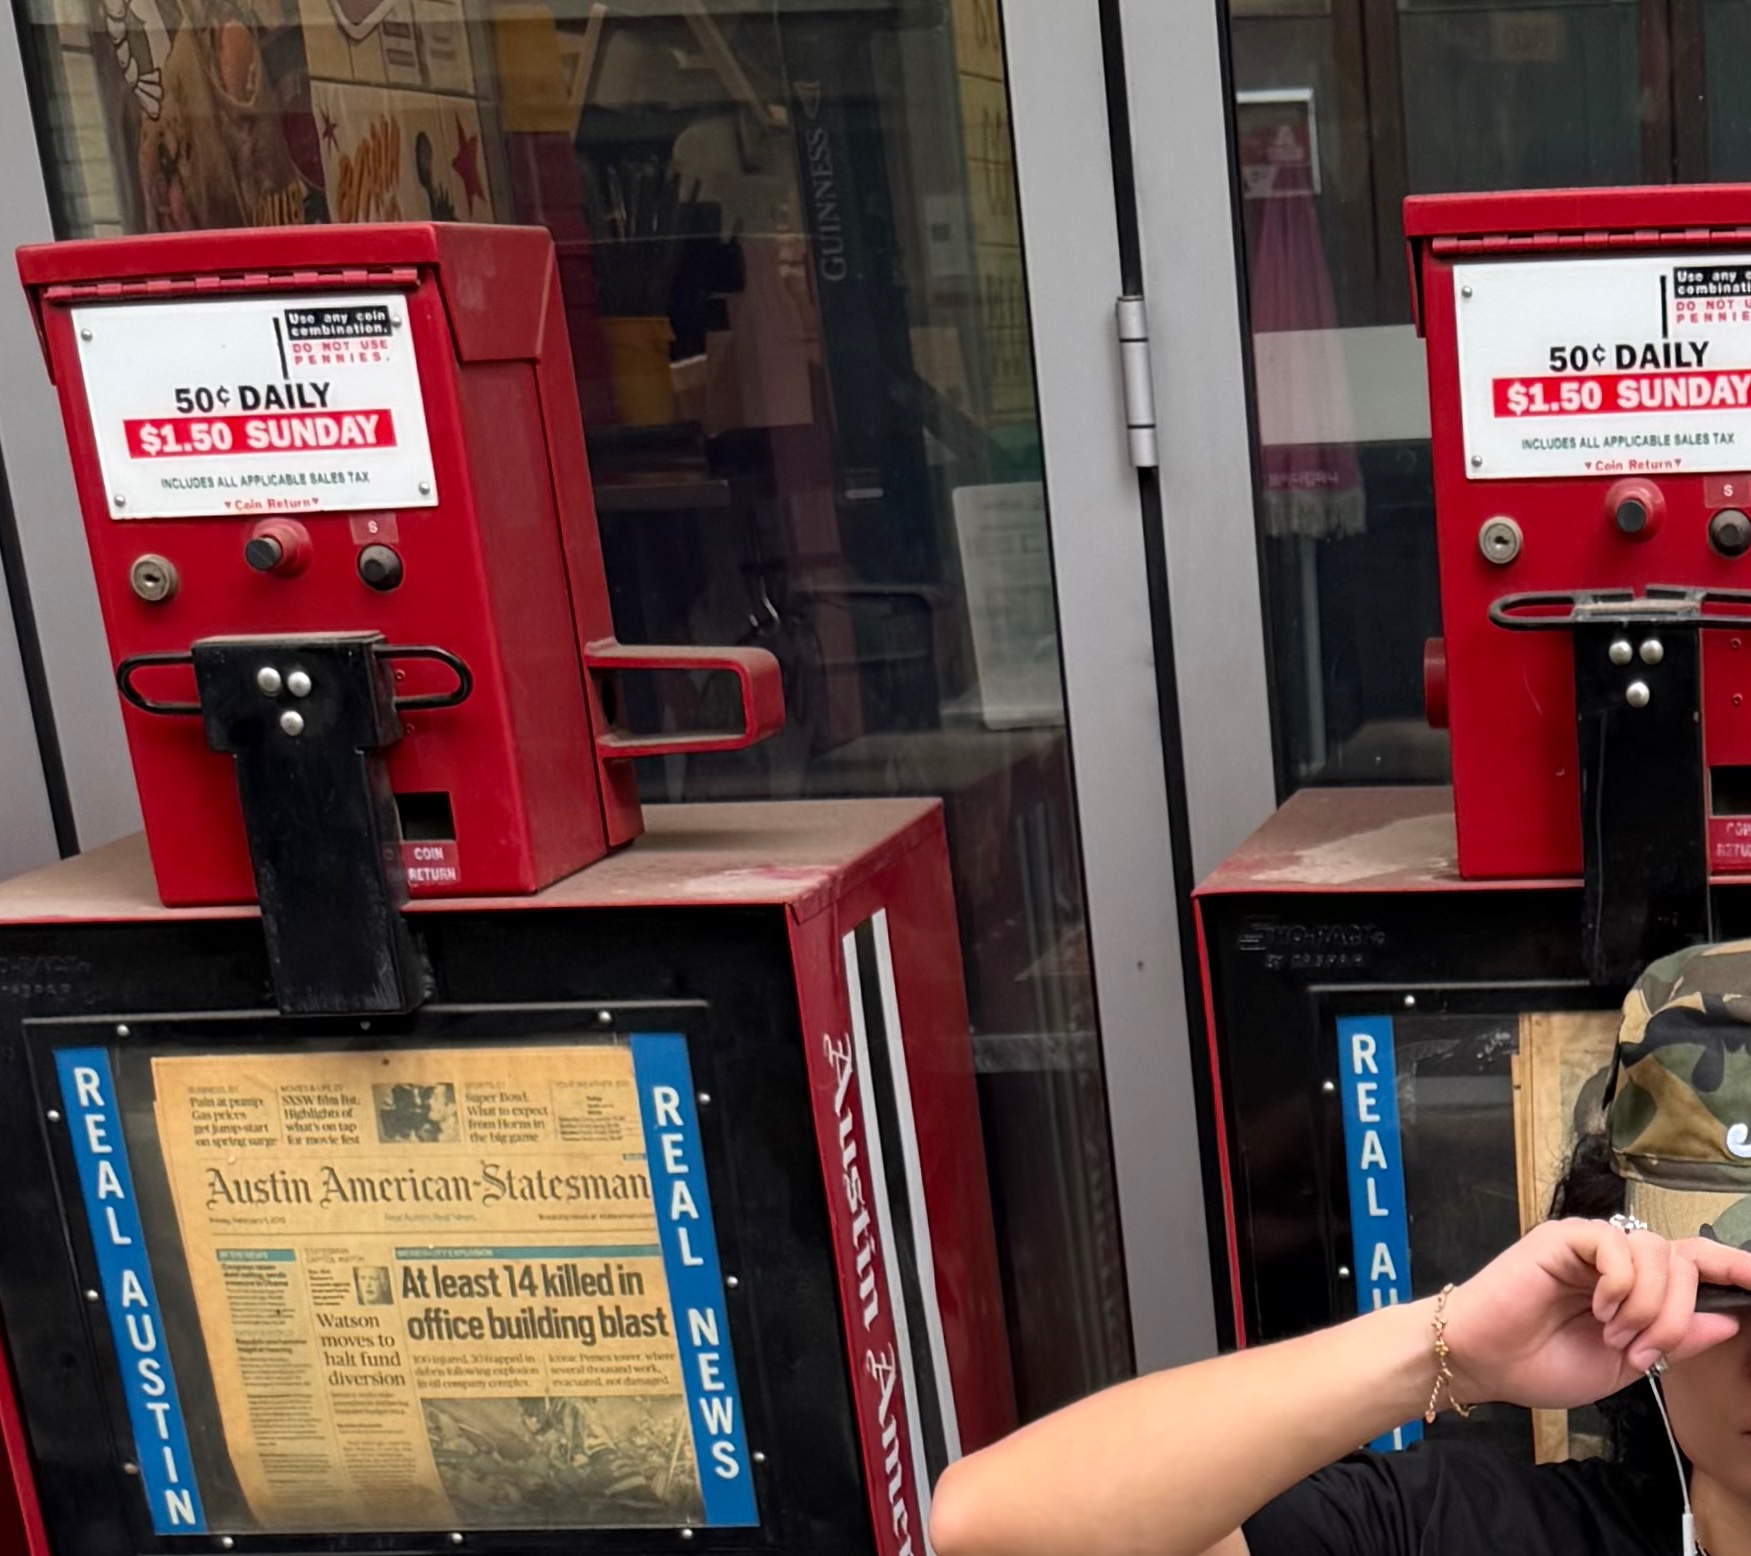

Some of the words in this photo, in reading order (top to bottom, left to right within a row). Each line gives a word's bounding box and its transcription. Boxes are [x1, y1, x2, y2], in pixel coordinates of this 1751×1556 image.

[807, 127, 848, 281] GUINNESS
[1677, 270, 1702, 284] Use
[1711, 270, 1736, 285] any
[1676, 300, 1696, 312] DO
[1705, 299, 1735, 311] NOT
[289, 311, 315, 325] Use
[324, 311, 348, 325] any
[356, 309, 386, 322] coin
[290, 322, 388, 338] combination.
[292, 341, 312, 353] DO
[322, 340, 351, 352] NOT
[360, 339, 389, 351] USE
[294, 352, 391, 366] PENNIES.
[1549, 343, 1606, 372] 50¢
[1615, 341, 1709, 370] DAILY
[175, 384, 231, 414] 50¢
[238, 382, 330, 412] DAILY
[1507, 382, 1603, 415] $1.50
[139, 422, 232, 456] $1.50
[246, 415, 379, 449] SUNDAY
[1521, 437, 1577, 450] INCLUDES
[1579, 436, 1600, 449] ALL
[1603, 434, 1671, 449] APPLICABLE
[1674, 433, 1710, 446] SALES
[1712, 432, 1735, 445] TAX
[1595, 459, 1624, 472] Coin
[1628, 458, 1673, 471] Return
[161, 476, 215, 490] INCLUDES
[217, 475, 238, 489] ALL
[240, 473, 308, 488] APPLICABLE
[310, 472, 345, 486] SALES
[348, 471, 370, 484] TAX
[1723, 484, 1733, 497] S
[235, 498, 263, 511] Coin
[268, 497, 311, 510] Return
[368, 520, 379, 534] S
[414, 847, 444, 861] COIN
[408, 866, 457, 881] RETURN
[1351, 1033, 1389, 1217] REAL
[206, 1167, 312, 1210] Austin
[319, 1159, 651, 1209] American-Statesman
[823, 1031, 880, 1329] Austin
[402, 1265, 428, 1298] At
[432, 1264, 502, 1298] least
[502, 1265, 538, 1297] 14
[541, 1263, 615, 1297] killed
[617, 1263, 645, 1296] in
[652, 1086, 704, 1270] REAL
[689, 1308, 741, 1481] NEWS
[73, 1066, 132, 1247] REAL
[121, 1270, 196, 1527] AUSTIN
[317, 1313, 380, 1329] Watson
[407, 1307, 484, 1340] office
[486, 1305, 597, 1346] building
[598, 1304, 670, 1338] blast
[321, 1335, 375, 1348] moves
[378, 1333, 396, 1347] to
[324, 1351, 357, 1367] halt
[360, 1351, 402, 1367] fund
[329, 1370, 406, 1387] diversion
